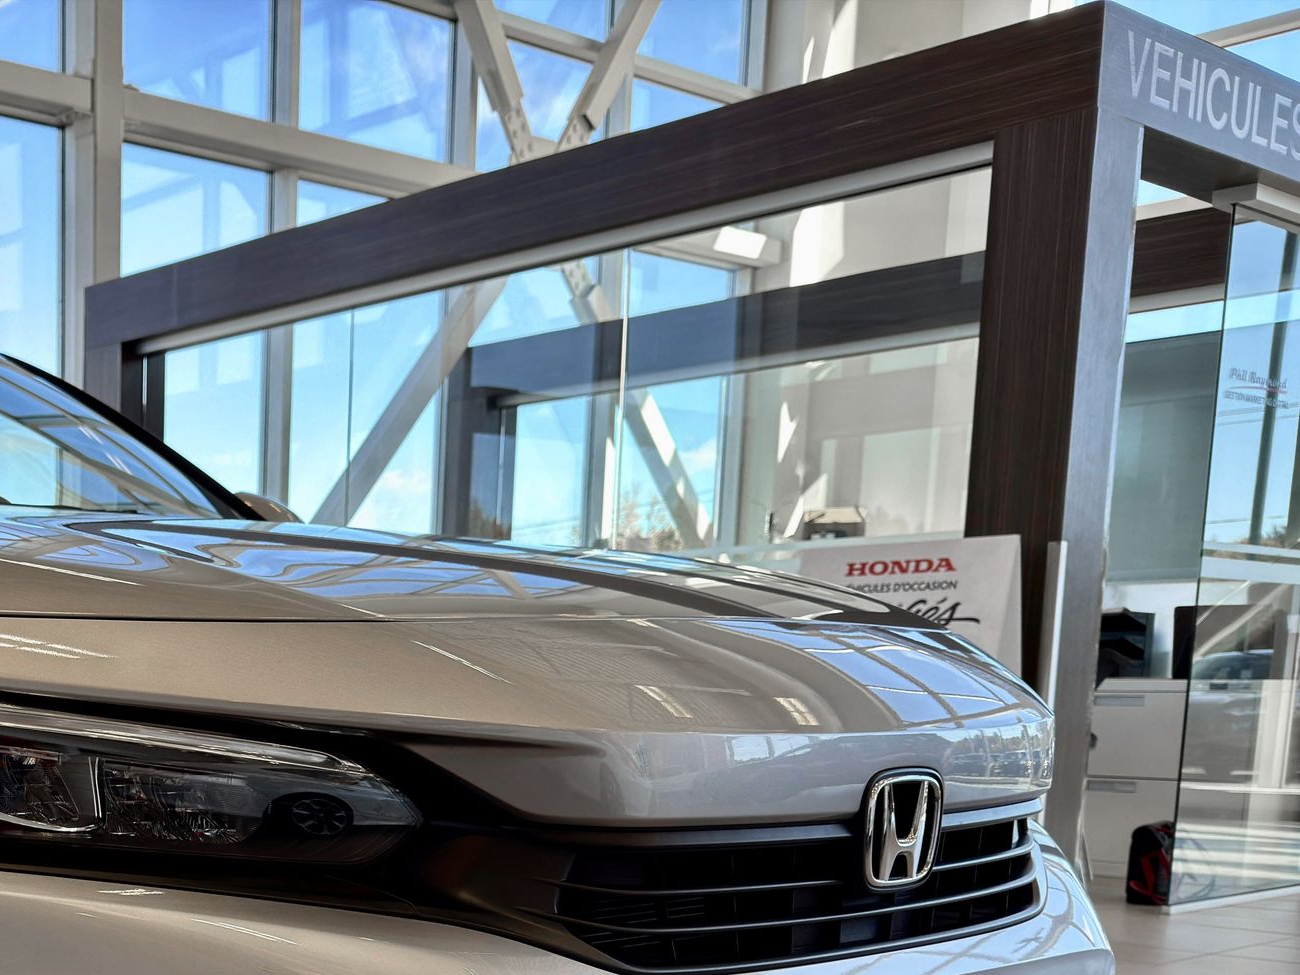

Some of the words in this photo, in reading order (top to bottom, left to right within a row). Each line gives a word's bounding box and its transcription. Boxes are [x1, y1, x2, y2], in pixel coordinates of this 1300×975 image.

[845, 558, 957, 577] HONDA
[847, 581, 891, 594] HICULES
[892, 580, 958, 593] D'OCCASION
